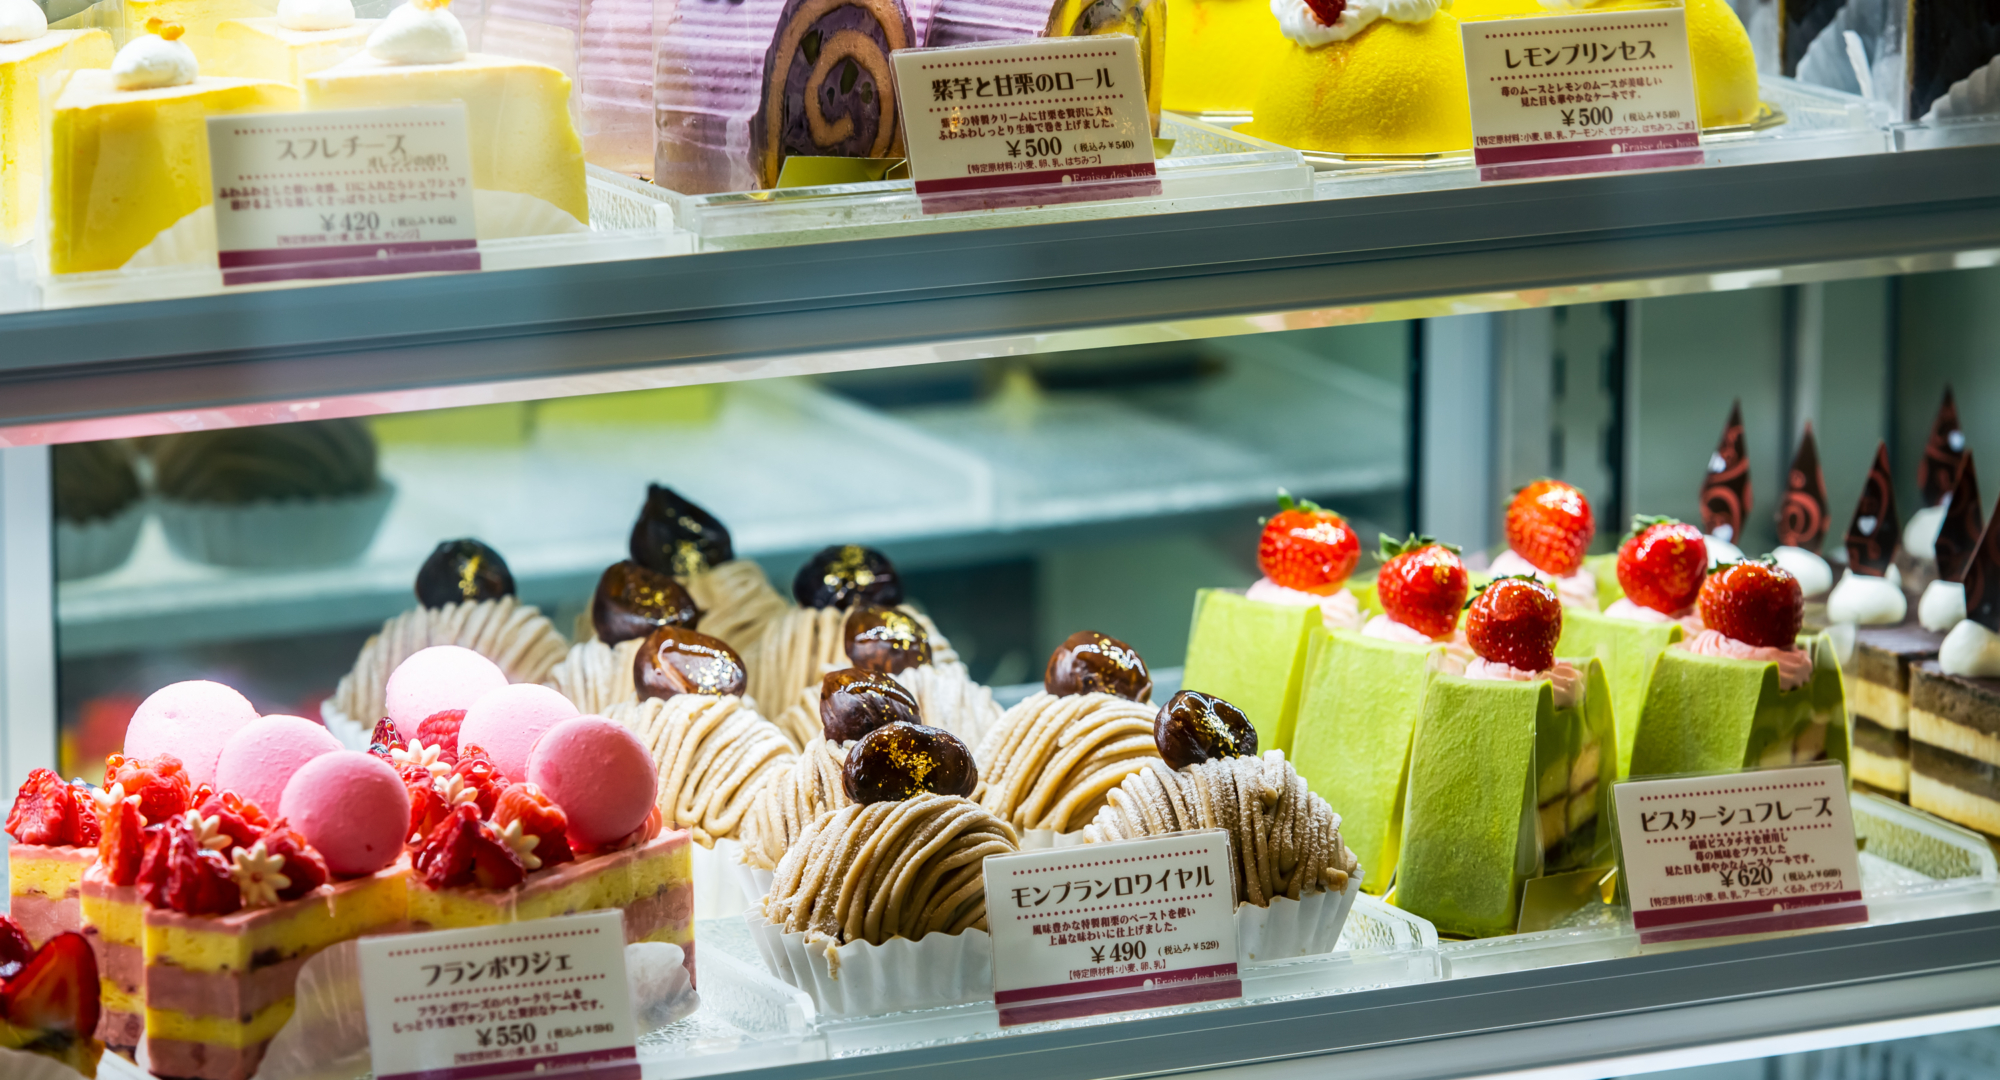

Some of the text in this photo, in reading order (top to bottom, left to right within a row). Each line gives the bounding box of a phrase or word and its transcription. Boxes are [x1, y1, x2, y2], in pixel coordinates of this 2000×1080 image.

[1505, 40, 1655, 68] レモンプリンセス
[932, 68, 1114, 101] 紫芋と甘栗のロール
[1501, 77, 1662, 97] 苺のムースとレモンのムースが美味しい
[1521, 90, 1641, 107] 見た目も華やかなケーキです。
[1561, 106, 1613, 127] ¥500
[939, 118, 1116, 140] ふわふわしっとり生地で巻き上げました。
[1006, 137, 1062, 158] ¥500
[320, 212, 379, 231] ¥420
[1641, 797, 1832, 832] ピスターシュフレーズ
[1695, 844, 1786, 861] 苺の風味をプラスした
[1011, 865, 1214, 908] モンブランロワイヤル
[1720, 867, 1772, 887] ¥620
[1032, 907, 1196, 935] 風味豊かな特製和栗のペーストを使い
[1048, 925, 1178, 946] 上品な味わいに仕上げました。
[1091, 941, 1220, 964] ¥490 (税込み¥529)
[421, 951, 572, 986] フランボワジェ
[1069, 959, 1166, 980] 【特定原材料:小麦、卵、乳】
[476, 1023, 537, 1047] ¥550
